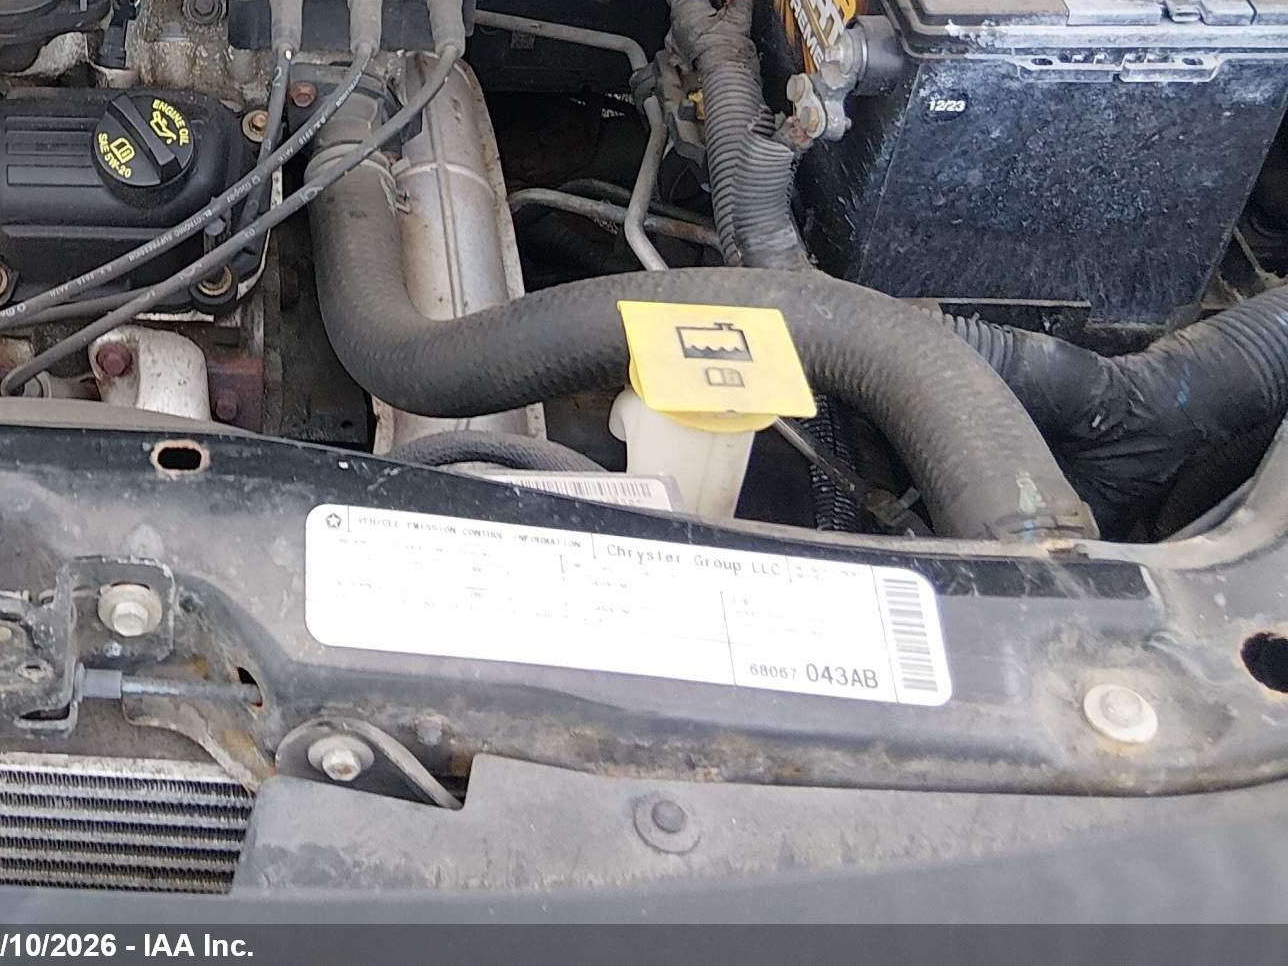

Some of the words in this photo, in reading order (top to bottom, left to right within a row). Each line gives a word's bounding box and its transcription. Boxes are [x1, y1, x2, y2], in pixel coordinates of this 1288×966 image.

[152, 99, 185, 130] ENGINE
[178, 128, 190, 146] OIL
[98, 132, 110, 154] SAE
[104, 152, 132, 179] 5W-20
[606, 543, 682, 565] Chrysler
[693, 554, 742, 575] Group
[751, 562, 780, 576] LLC
[749, 662, 797, 680] 68067
[805, 663, 879, 689] 043AB
